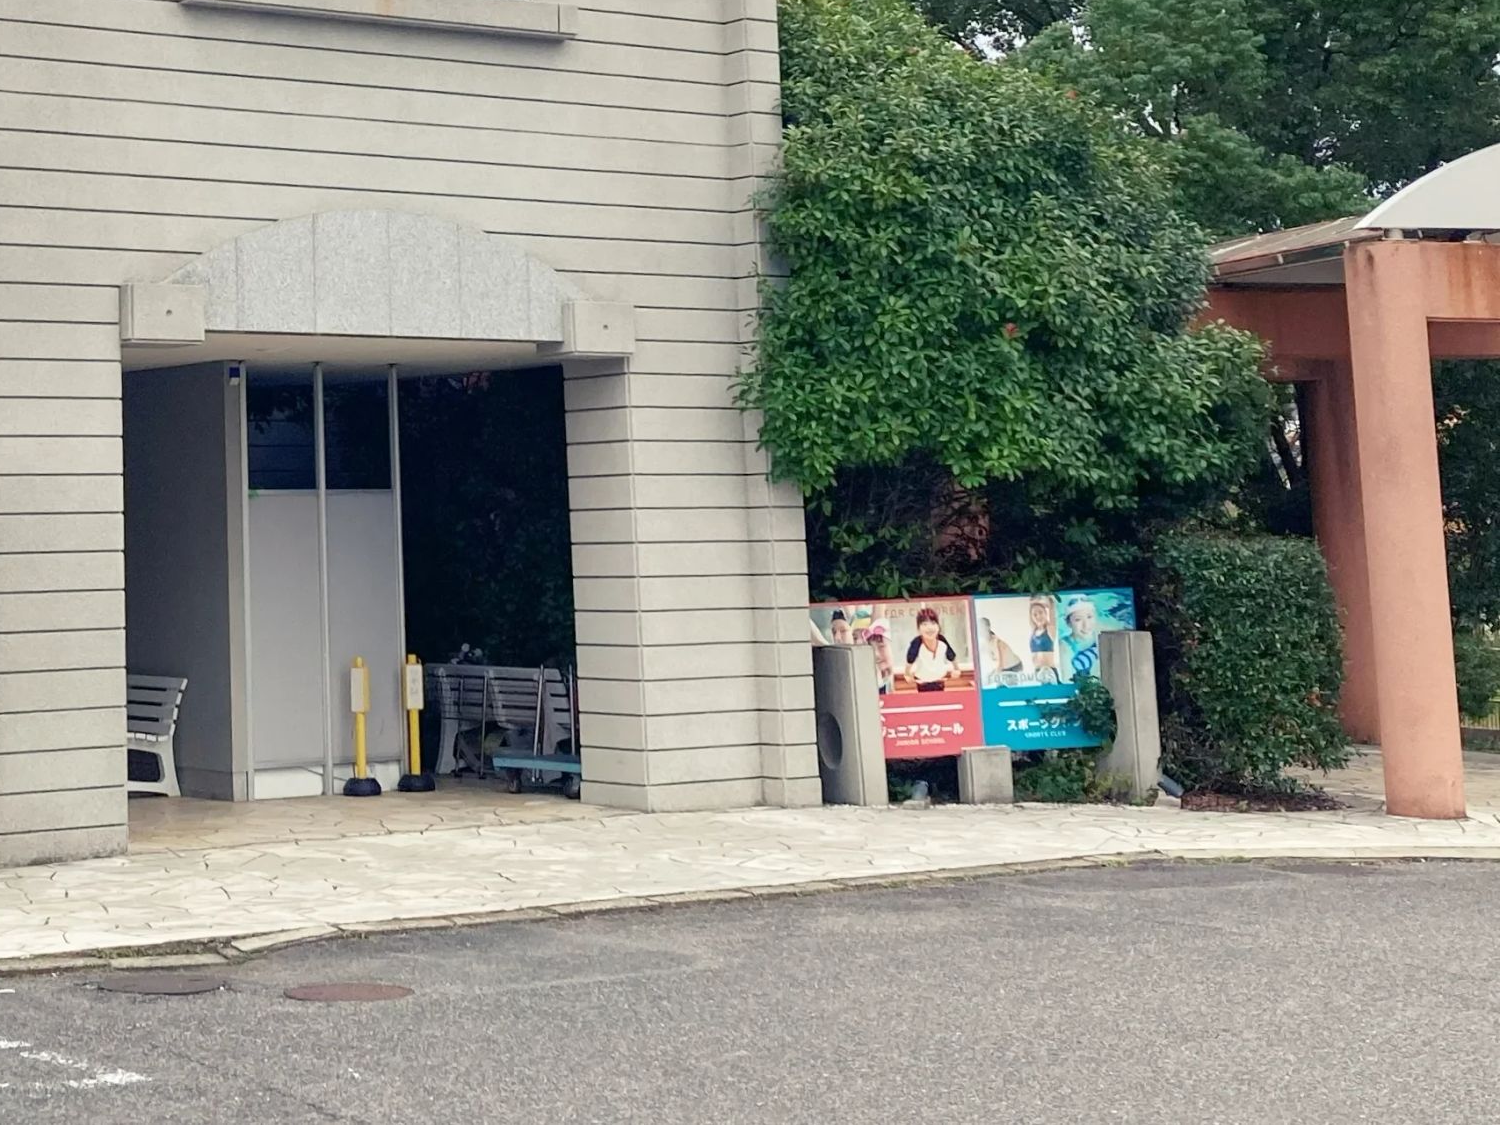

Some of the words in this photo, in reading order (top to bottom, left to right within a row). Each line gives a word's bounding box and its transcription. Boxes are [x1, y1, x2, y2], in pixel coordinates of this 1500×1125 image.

[1006, 717, 1083, 731] スポーツク
